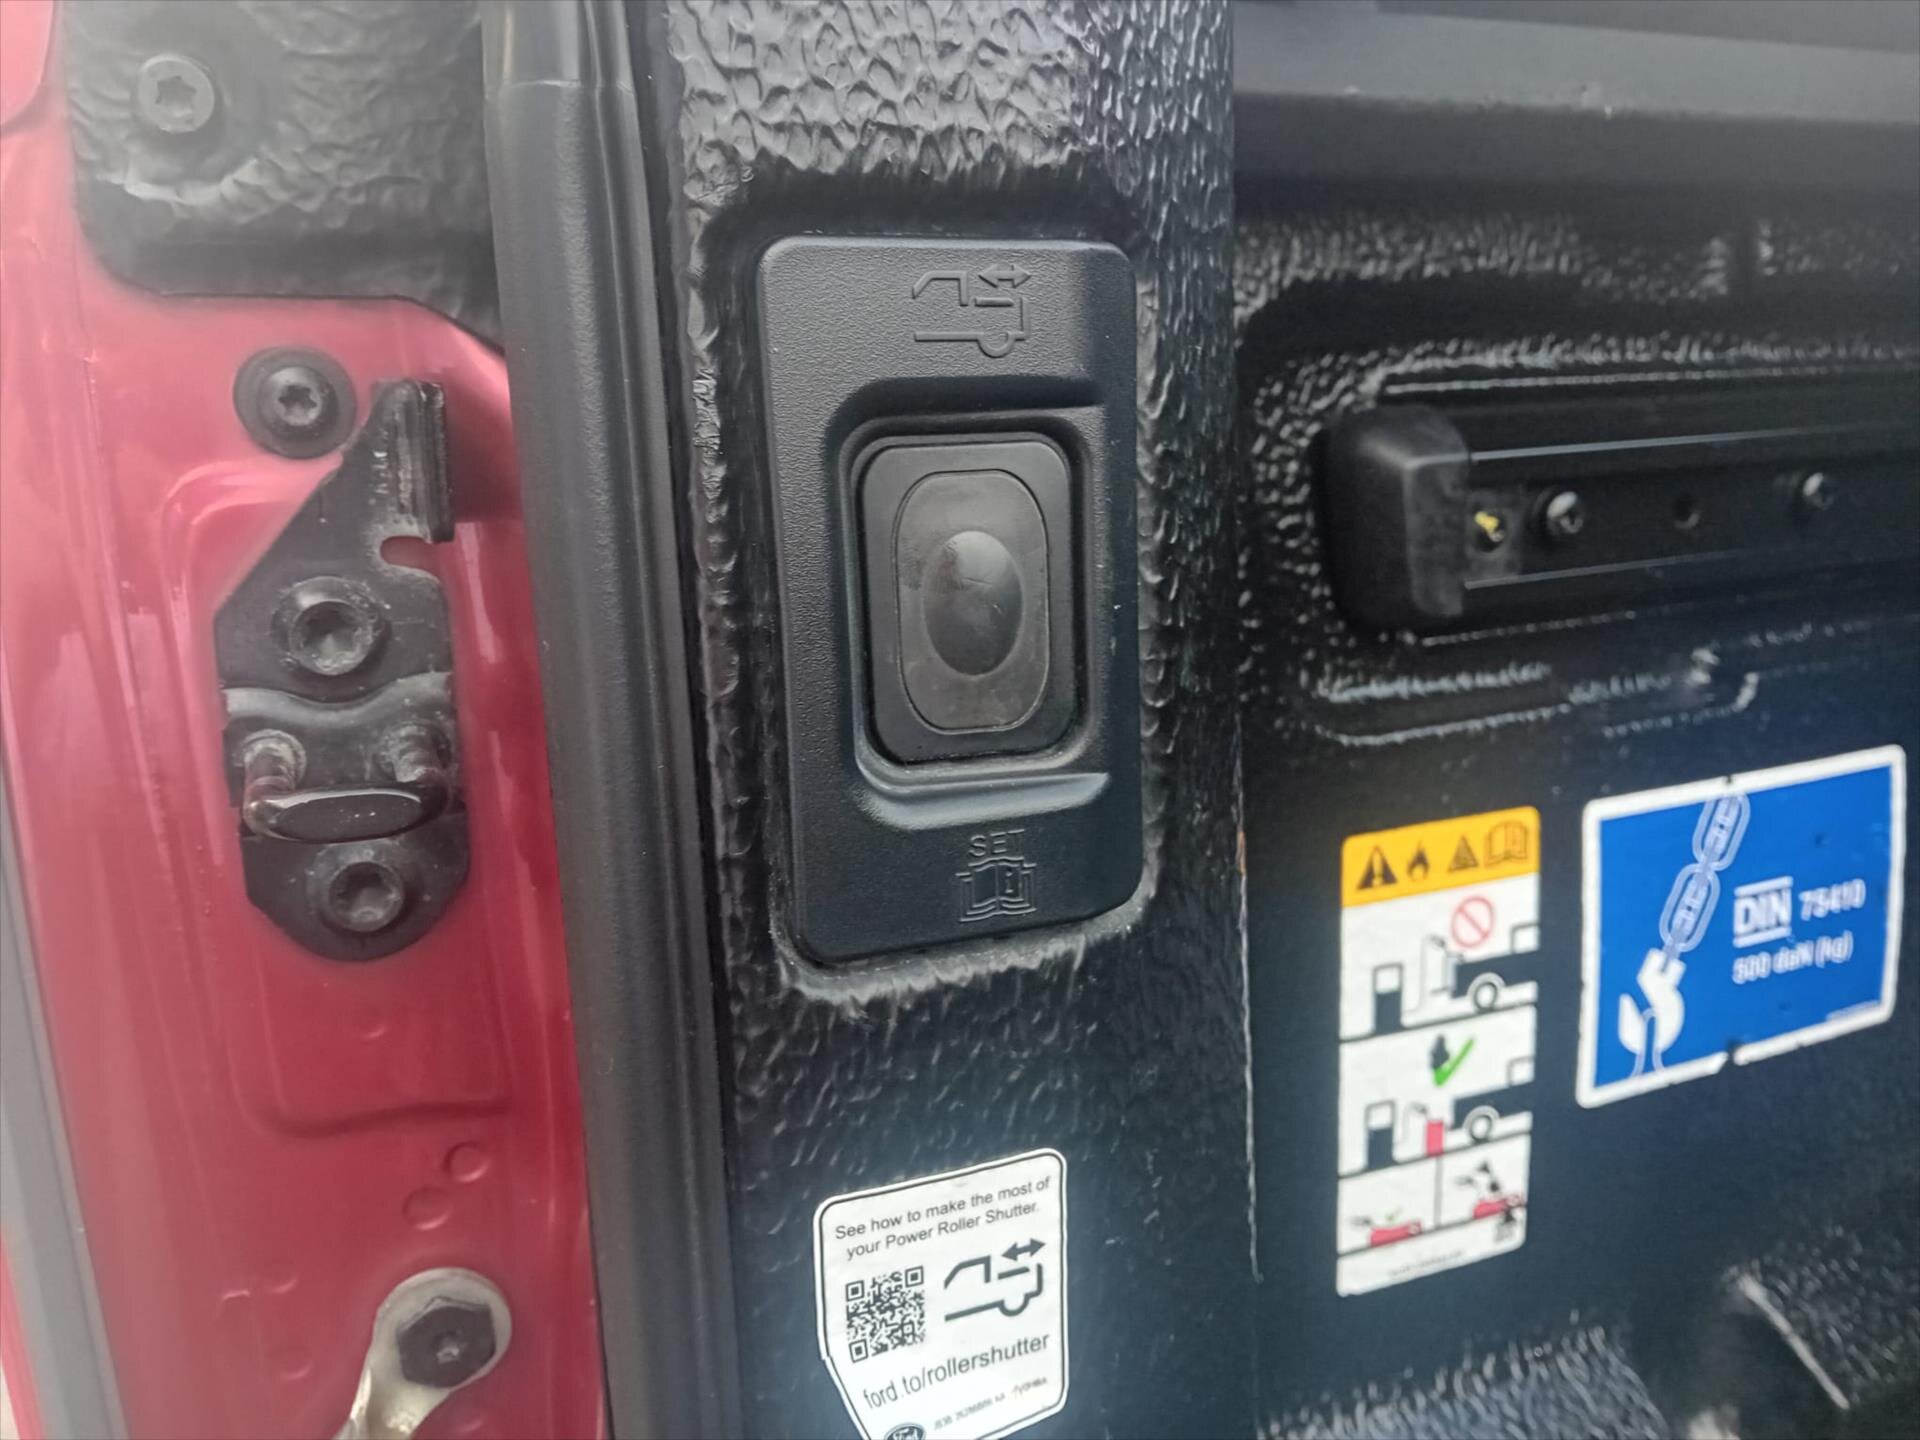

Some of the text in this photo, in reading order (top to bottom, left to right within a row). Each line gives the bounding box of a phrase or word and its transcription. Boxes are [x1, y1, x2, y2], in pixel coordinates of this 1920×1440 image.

[968, 828, 1025, 857] SET
[1733, 884, 1792, 938] DIN
[835, 1175, 1051, 1240] See how to make the most of
[846, 1200, 1041, 1262] your Power Roller Shutter.
[863, 1333, 1050, 1410] ford.to/rollershutter
